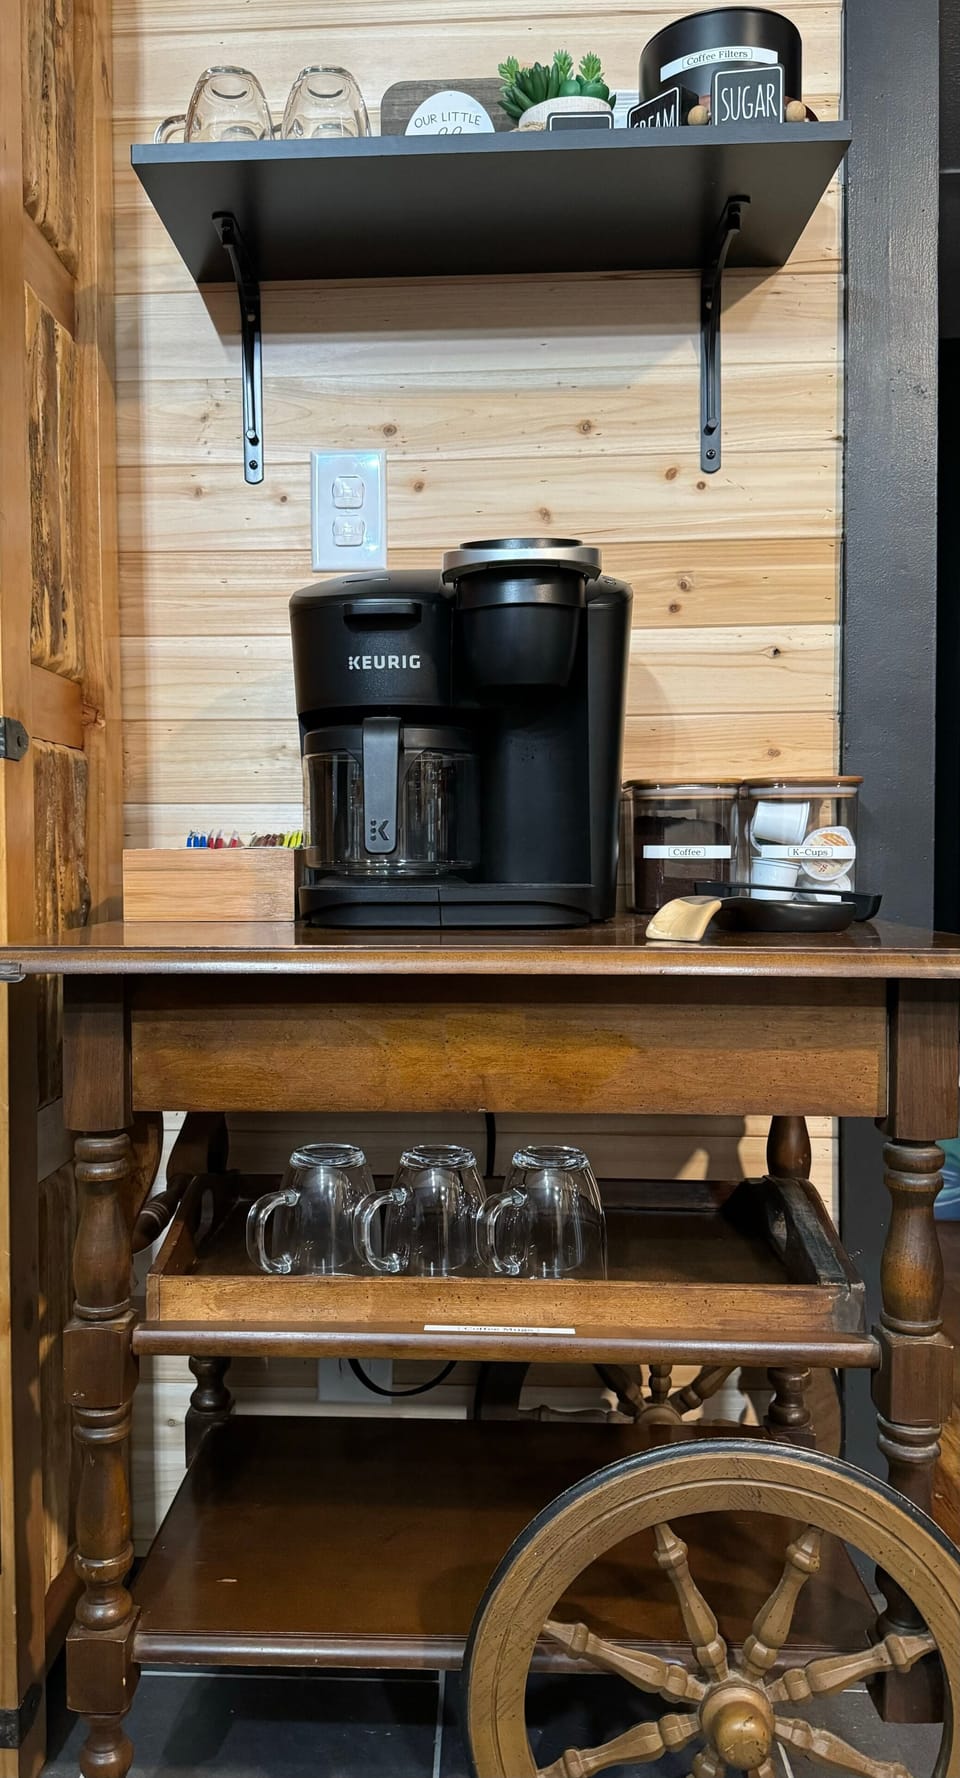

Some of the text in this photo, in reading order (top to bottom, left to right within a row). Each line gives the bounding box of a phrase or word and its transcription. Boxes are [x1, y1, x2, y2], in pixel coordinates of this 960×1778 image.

[686, 50, 748, 66] Coffee Filters
[721, 83, 778, 122] SUGAR
[414, 111, 482, 128] OUR LITTLE
[348, 655, 421, 670] KEURIG
[673, 848, 702, 856] Coffee
[792, 848, 829, 857] K-Cups
